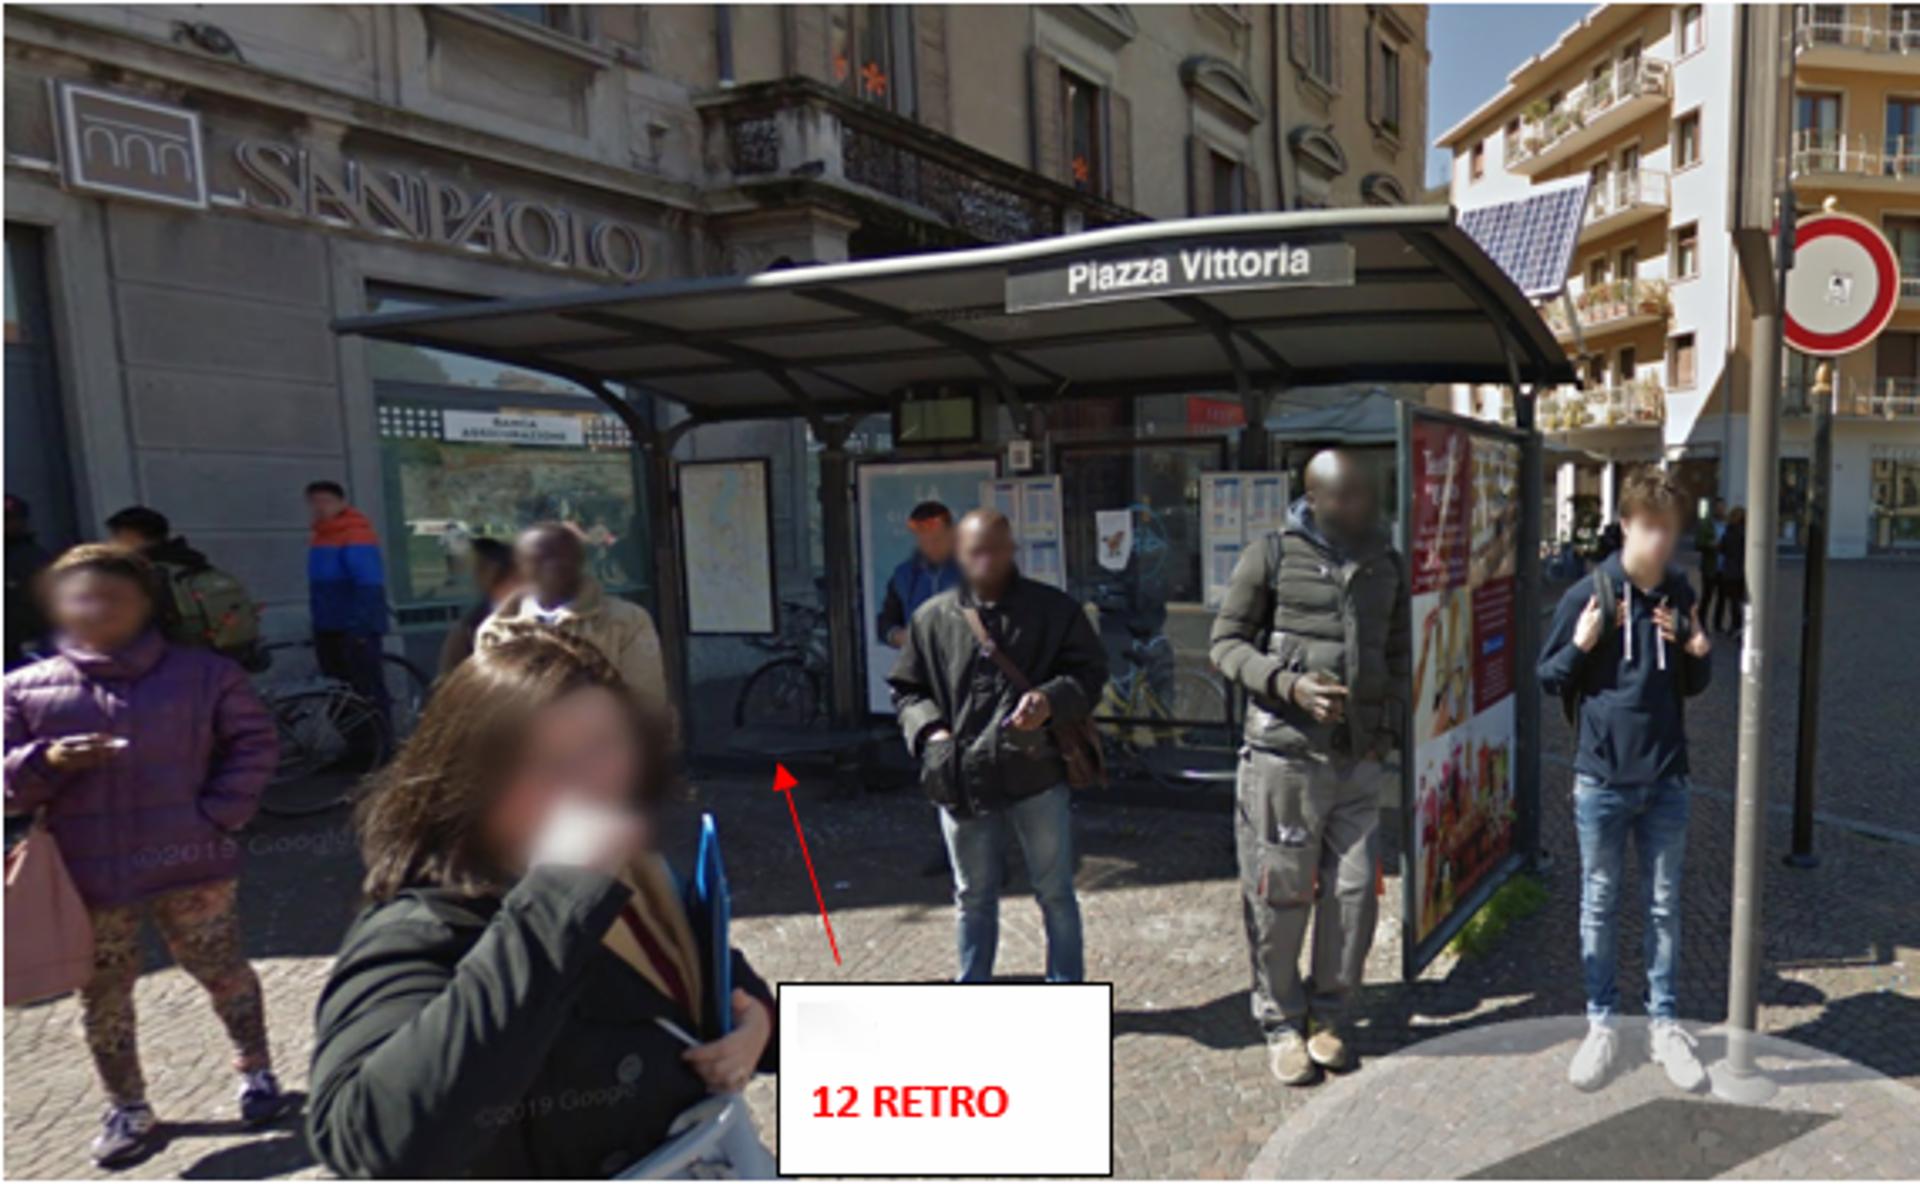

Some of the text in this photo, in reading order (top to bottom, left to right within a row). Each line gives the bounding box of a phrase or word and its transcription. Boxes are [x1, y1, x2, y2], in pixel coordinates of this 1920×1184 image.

[234, 138, 651, 281] SANPAOLO
[1068, 243, 1310, 294] Piazza Vittoria
